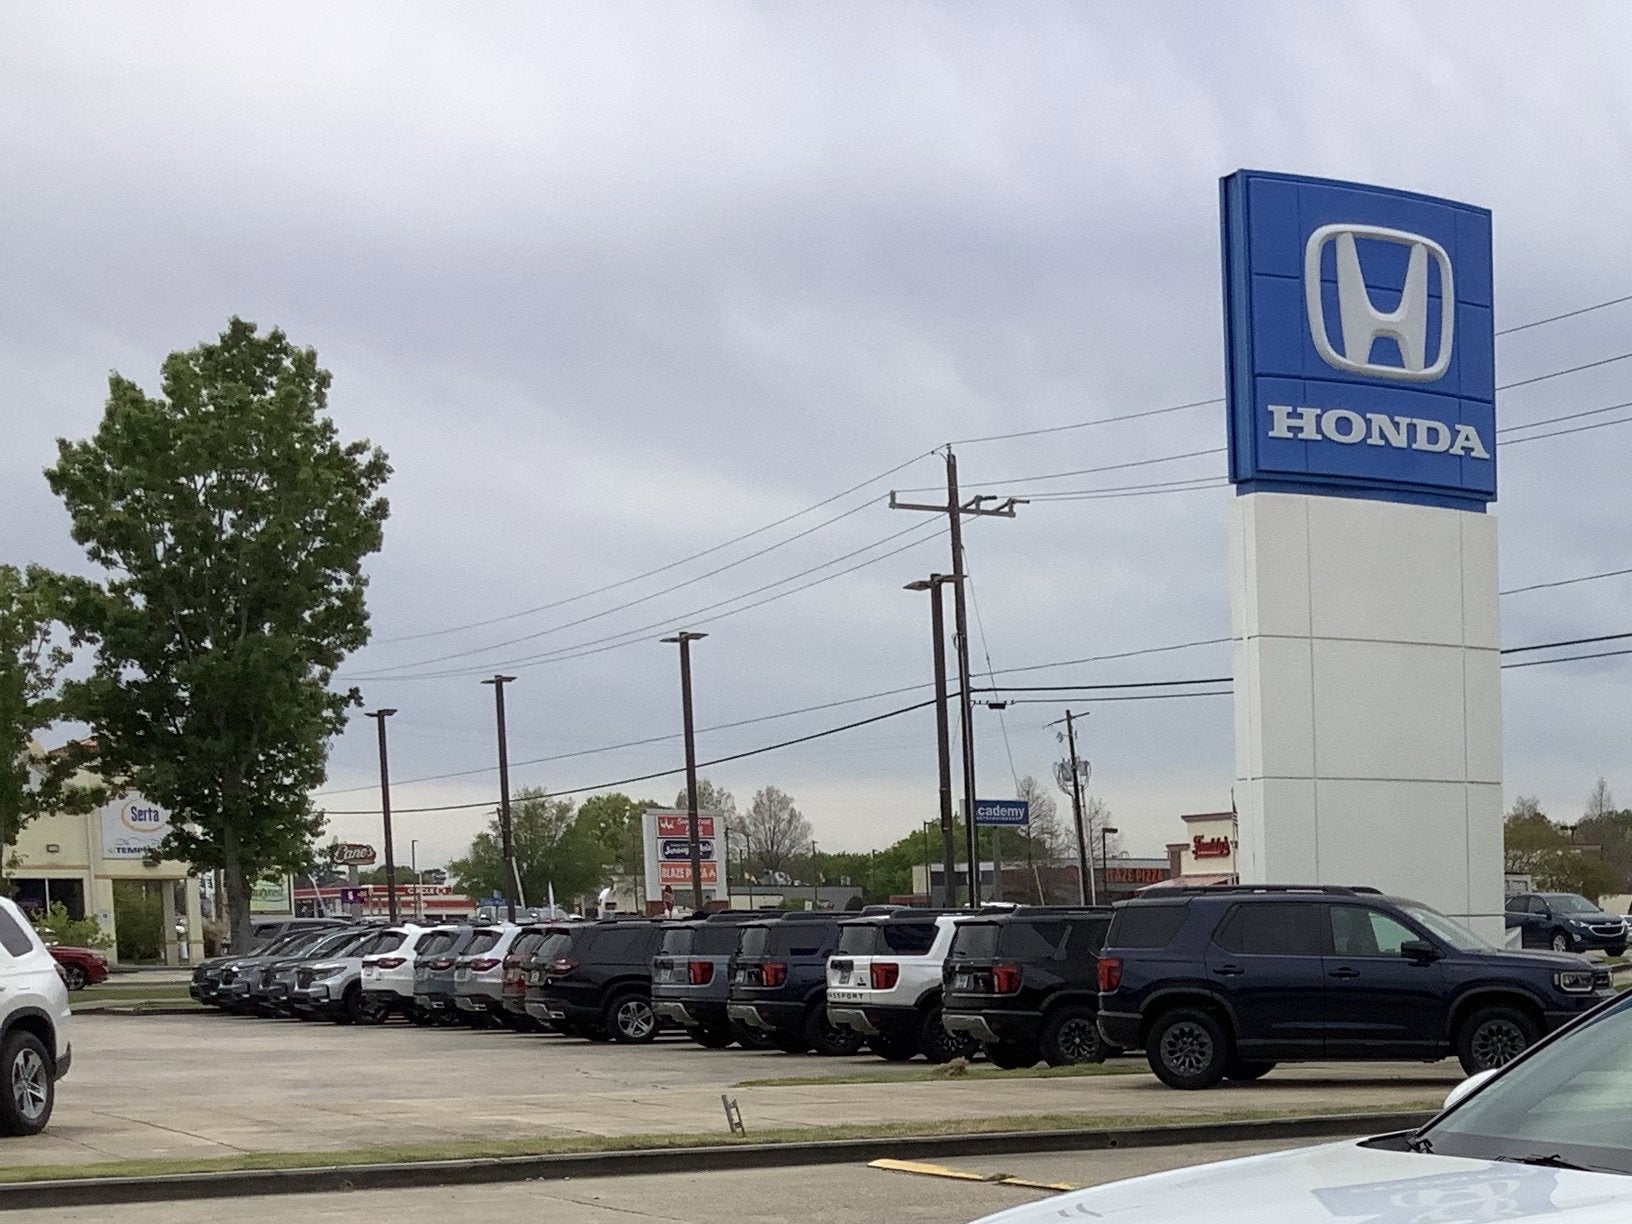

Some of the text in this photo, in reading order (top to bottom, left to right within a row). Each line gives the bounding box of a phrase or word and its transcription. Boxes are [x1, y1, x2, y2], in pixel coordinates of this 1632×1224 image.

[1267, 405, 1490, 459] HONDA
[130, 805, 160, 822] Serta
[976, 804, 1026, 820] cademy
[333, 844, 373, 863] Cane's
[1193, 835, 1230, 860] Freddy's
[661, 867, 685, 879] BLAZE
[1135, 868, 1164, 883] PIZZA
